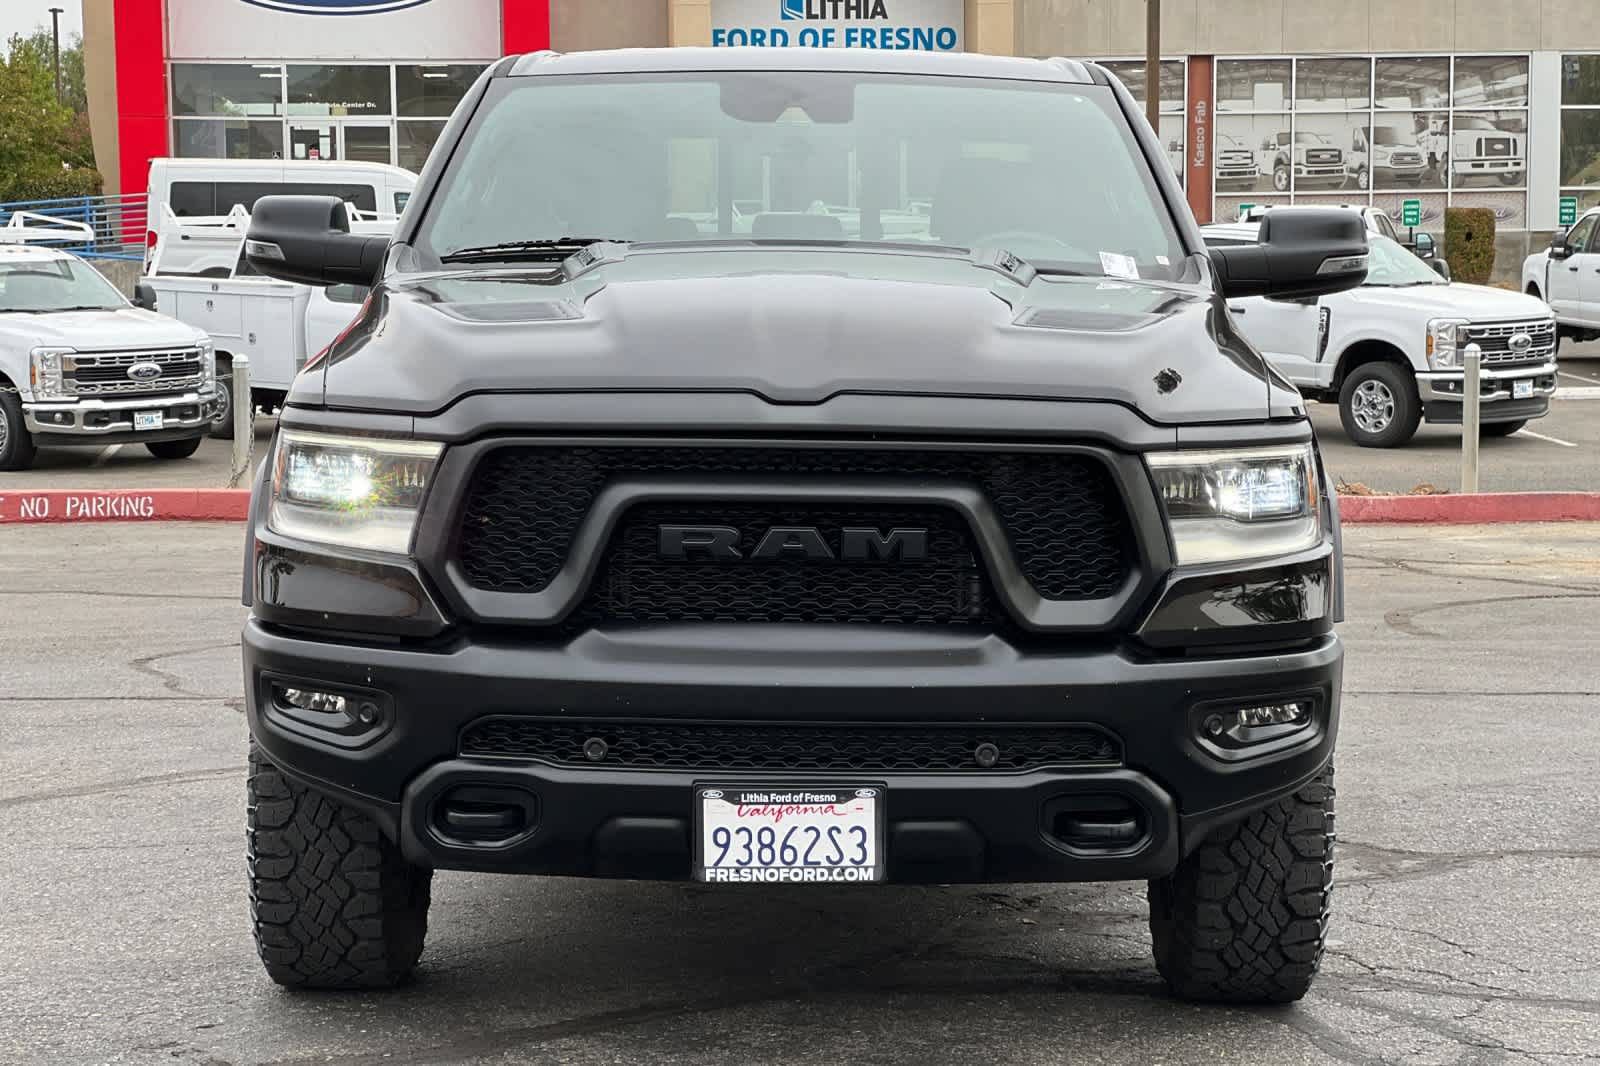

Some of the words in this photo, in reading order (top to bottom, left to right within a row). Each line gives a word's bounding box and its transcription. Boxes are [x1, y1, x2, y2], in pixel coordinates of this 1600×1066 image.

[805, 0, 888, 20] LITHIA
[712, 28, 789, 47] FORD
[799, 28, 836, 48] OF
[845, 27, 957, 51] FRESNO
[1194, 101, 1207, 124] Fab
[1193, 127, 1205, 167] Kasco
[20, 497, 49, 518] NO
[66, 496, 154, 518] PARKING
[658, 524, 929, 560] RAM
[741, 793, 768, 803] Lithia
[770, 793, 791, 803] Ford
[792, 793, 804, 803] of
[805, 792, 837, 803] Fresno
[737, 803, 847, 823] California
[712, 825, 868, 867] 93862S3
[705, 867, 874, 882] FRESNOFORD.COM
